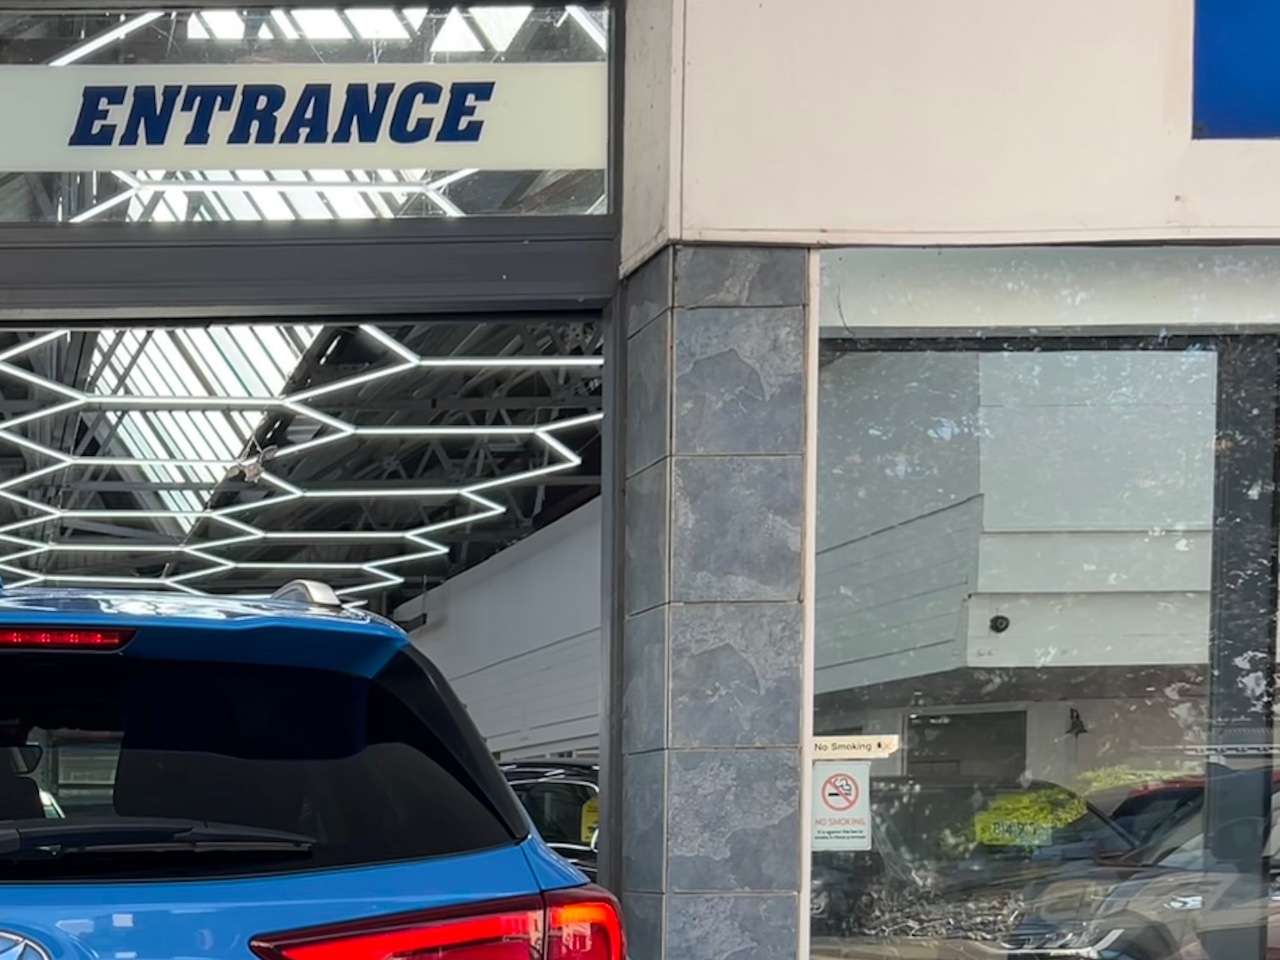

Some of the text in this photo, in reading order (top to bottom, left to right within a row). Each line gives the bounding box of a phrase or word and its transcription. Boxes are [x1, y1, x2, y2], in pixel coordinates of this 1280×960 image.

[68, 81, 496, 146] ENTRANCE
[814, 743, 873, 752] No Smoking
